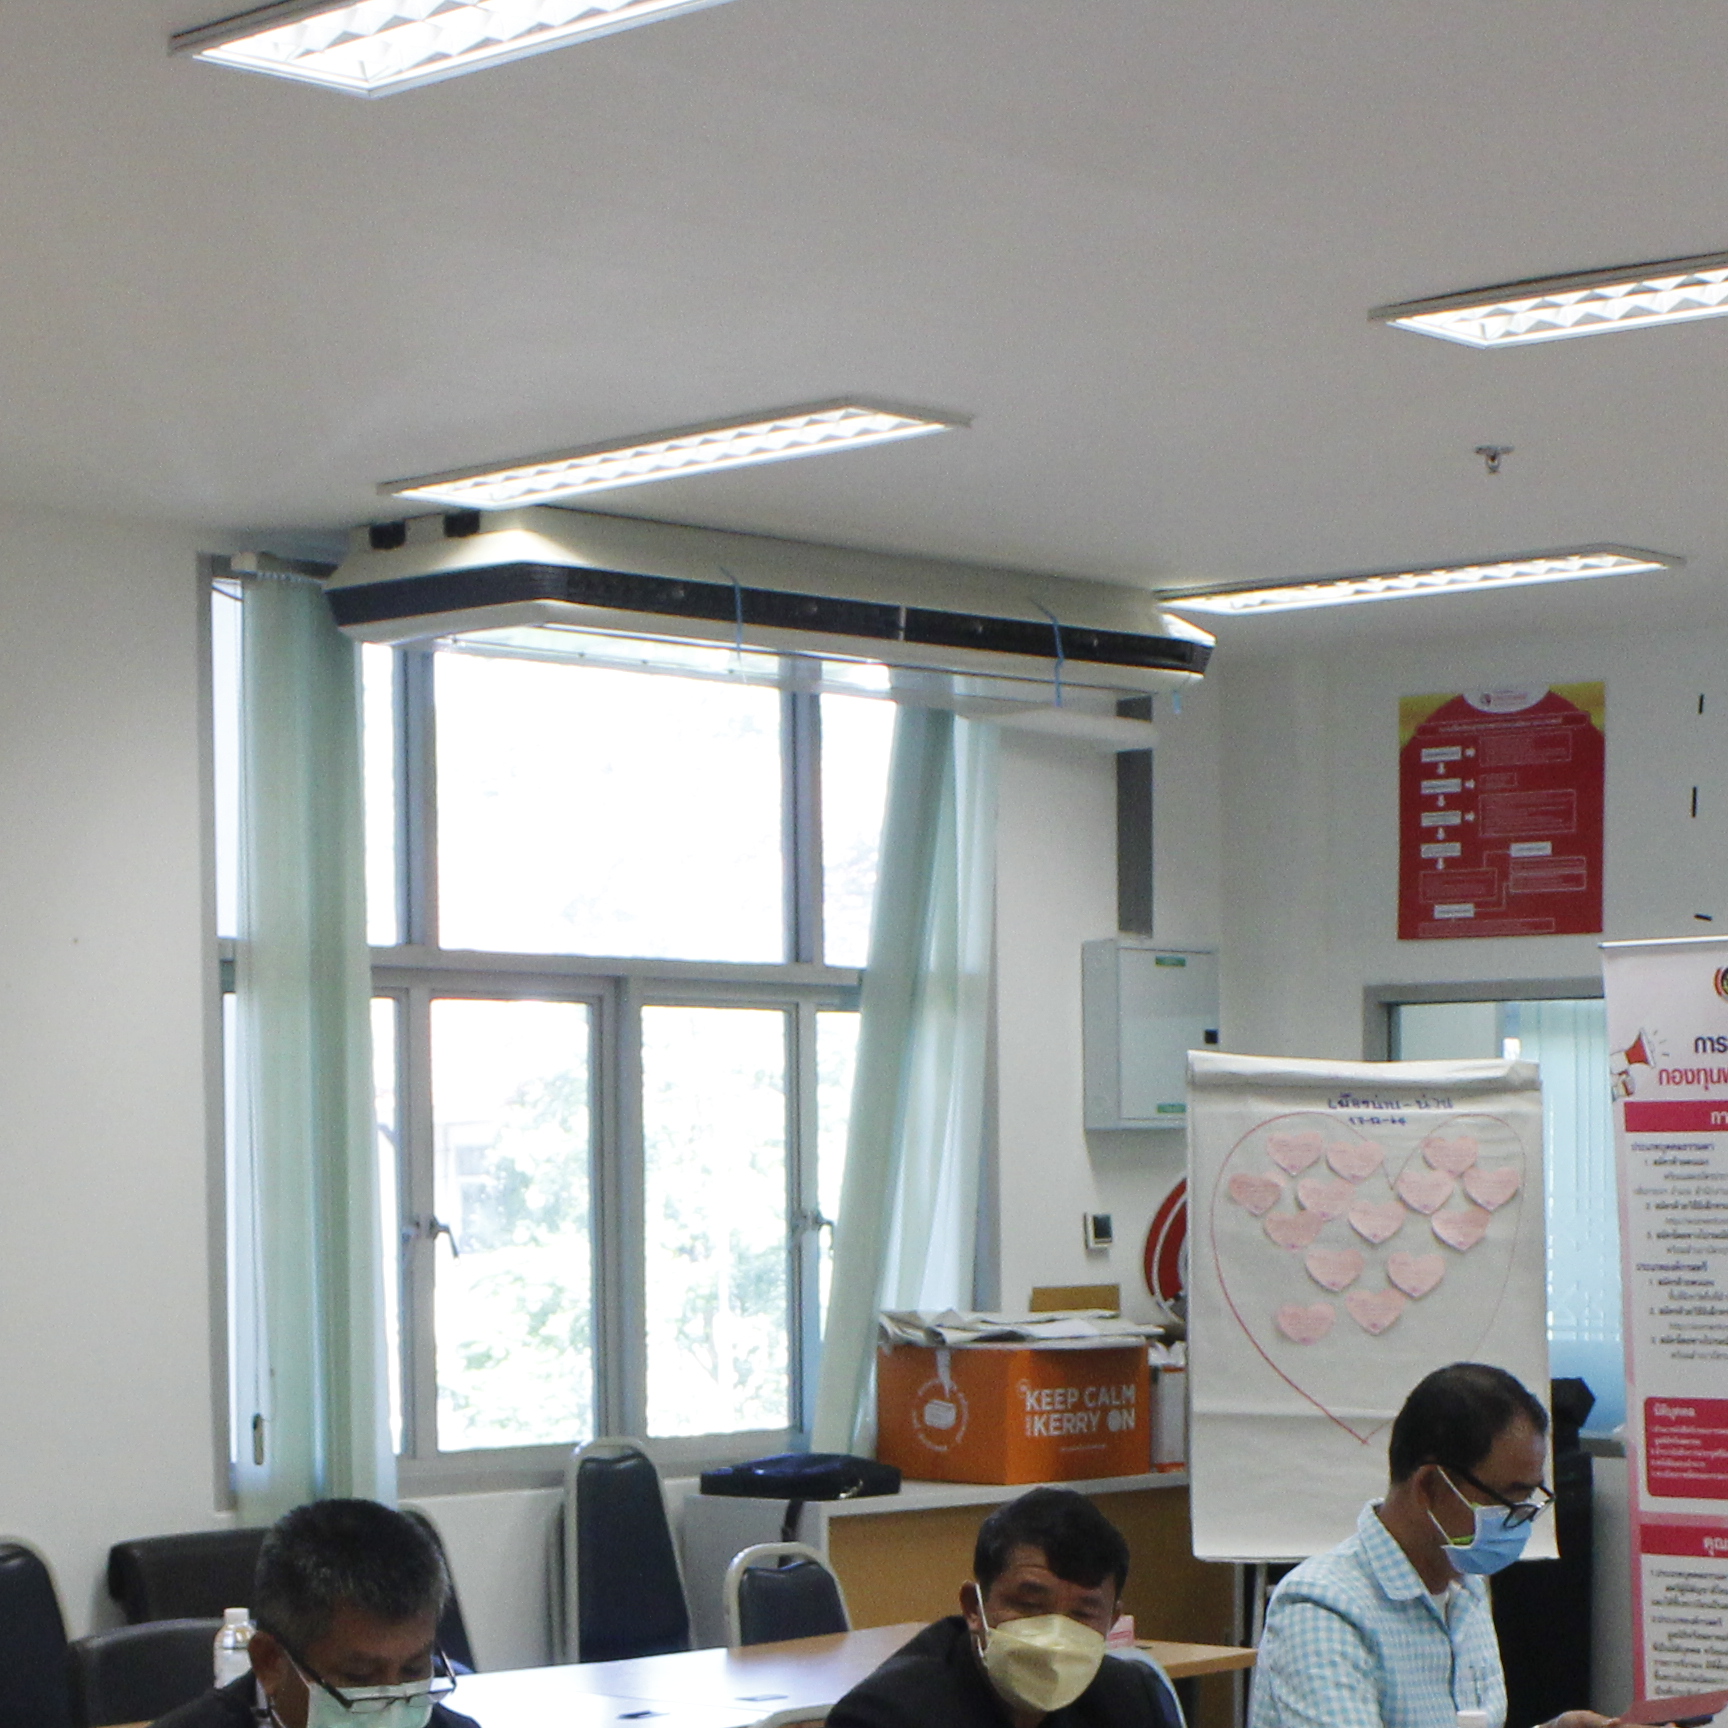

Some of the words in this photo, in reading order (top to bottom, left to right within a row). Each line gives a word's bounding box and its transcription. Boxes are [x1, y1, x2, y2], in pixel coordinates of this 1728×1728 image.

[1025, 1386, 1080, 1412] KEEP
[1083, 1383, 1136, 1408] CALM
[1033, 1410, 1101, 1437] KERRY
